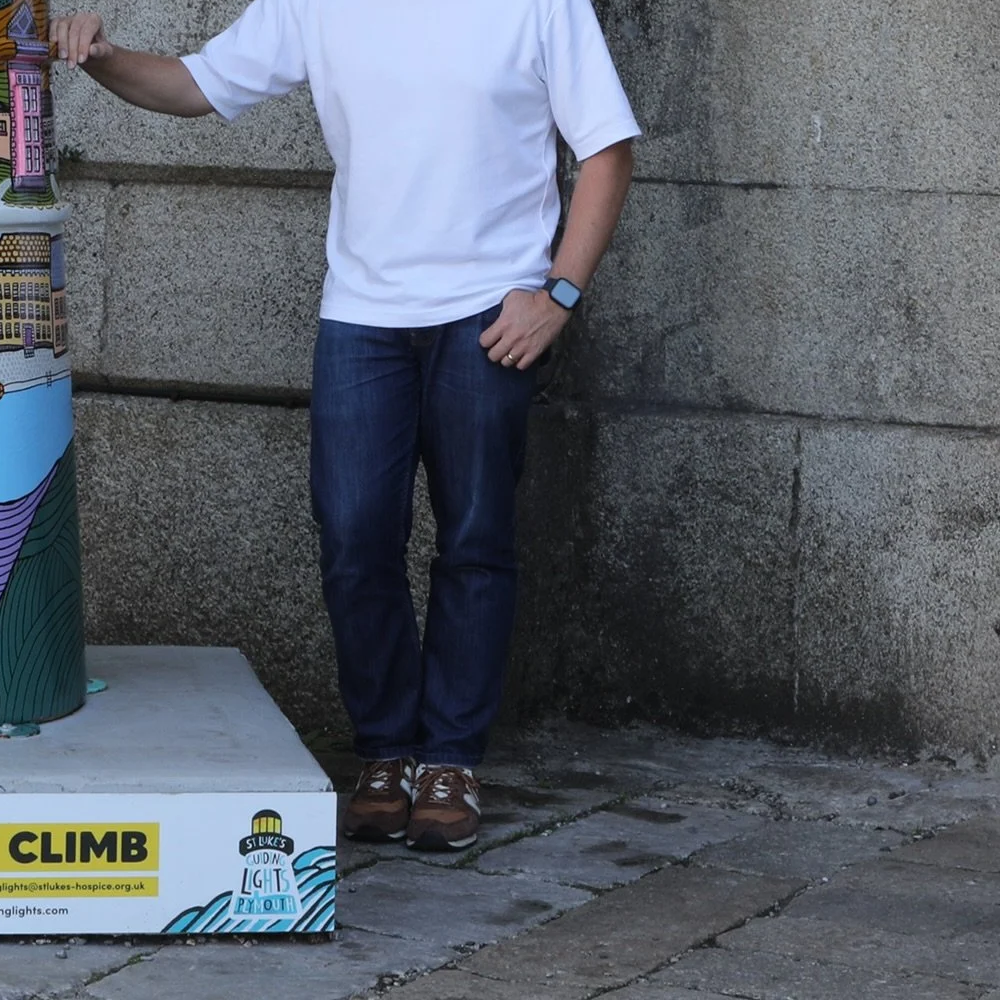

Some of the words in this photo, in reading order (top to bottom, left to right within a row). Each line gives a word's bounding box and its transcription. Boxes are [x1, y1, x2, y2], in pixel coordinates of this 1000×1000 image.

[9, 831, 148, 864] CLIMB
[246, 837, 258, 849] ST
[258, 836, 286, 848] LUKE'S
[245, 853, 286, 866] GUIDING
[241, 868, 290, 895] LIGHTS
[238, 895, 296, 913] PLYMOUTH
